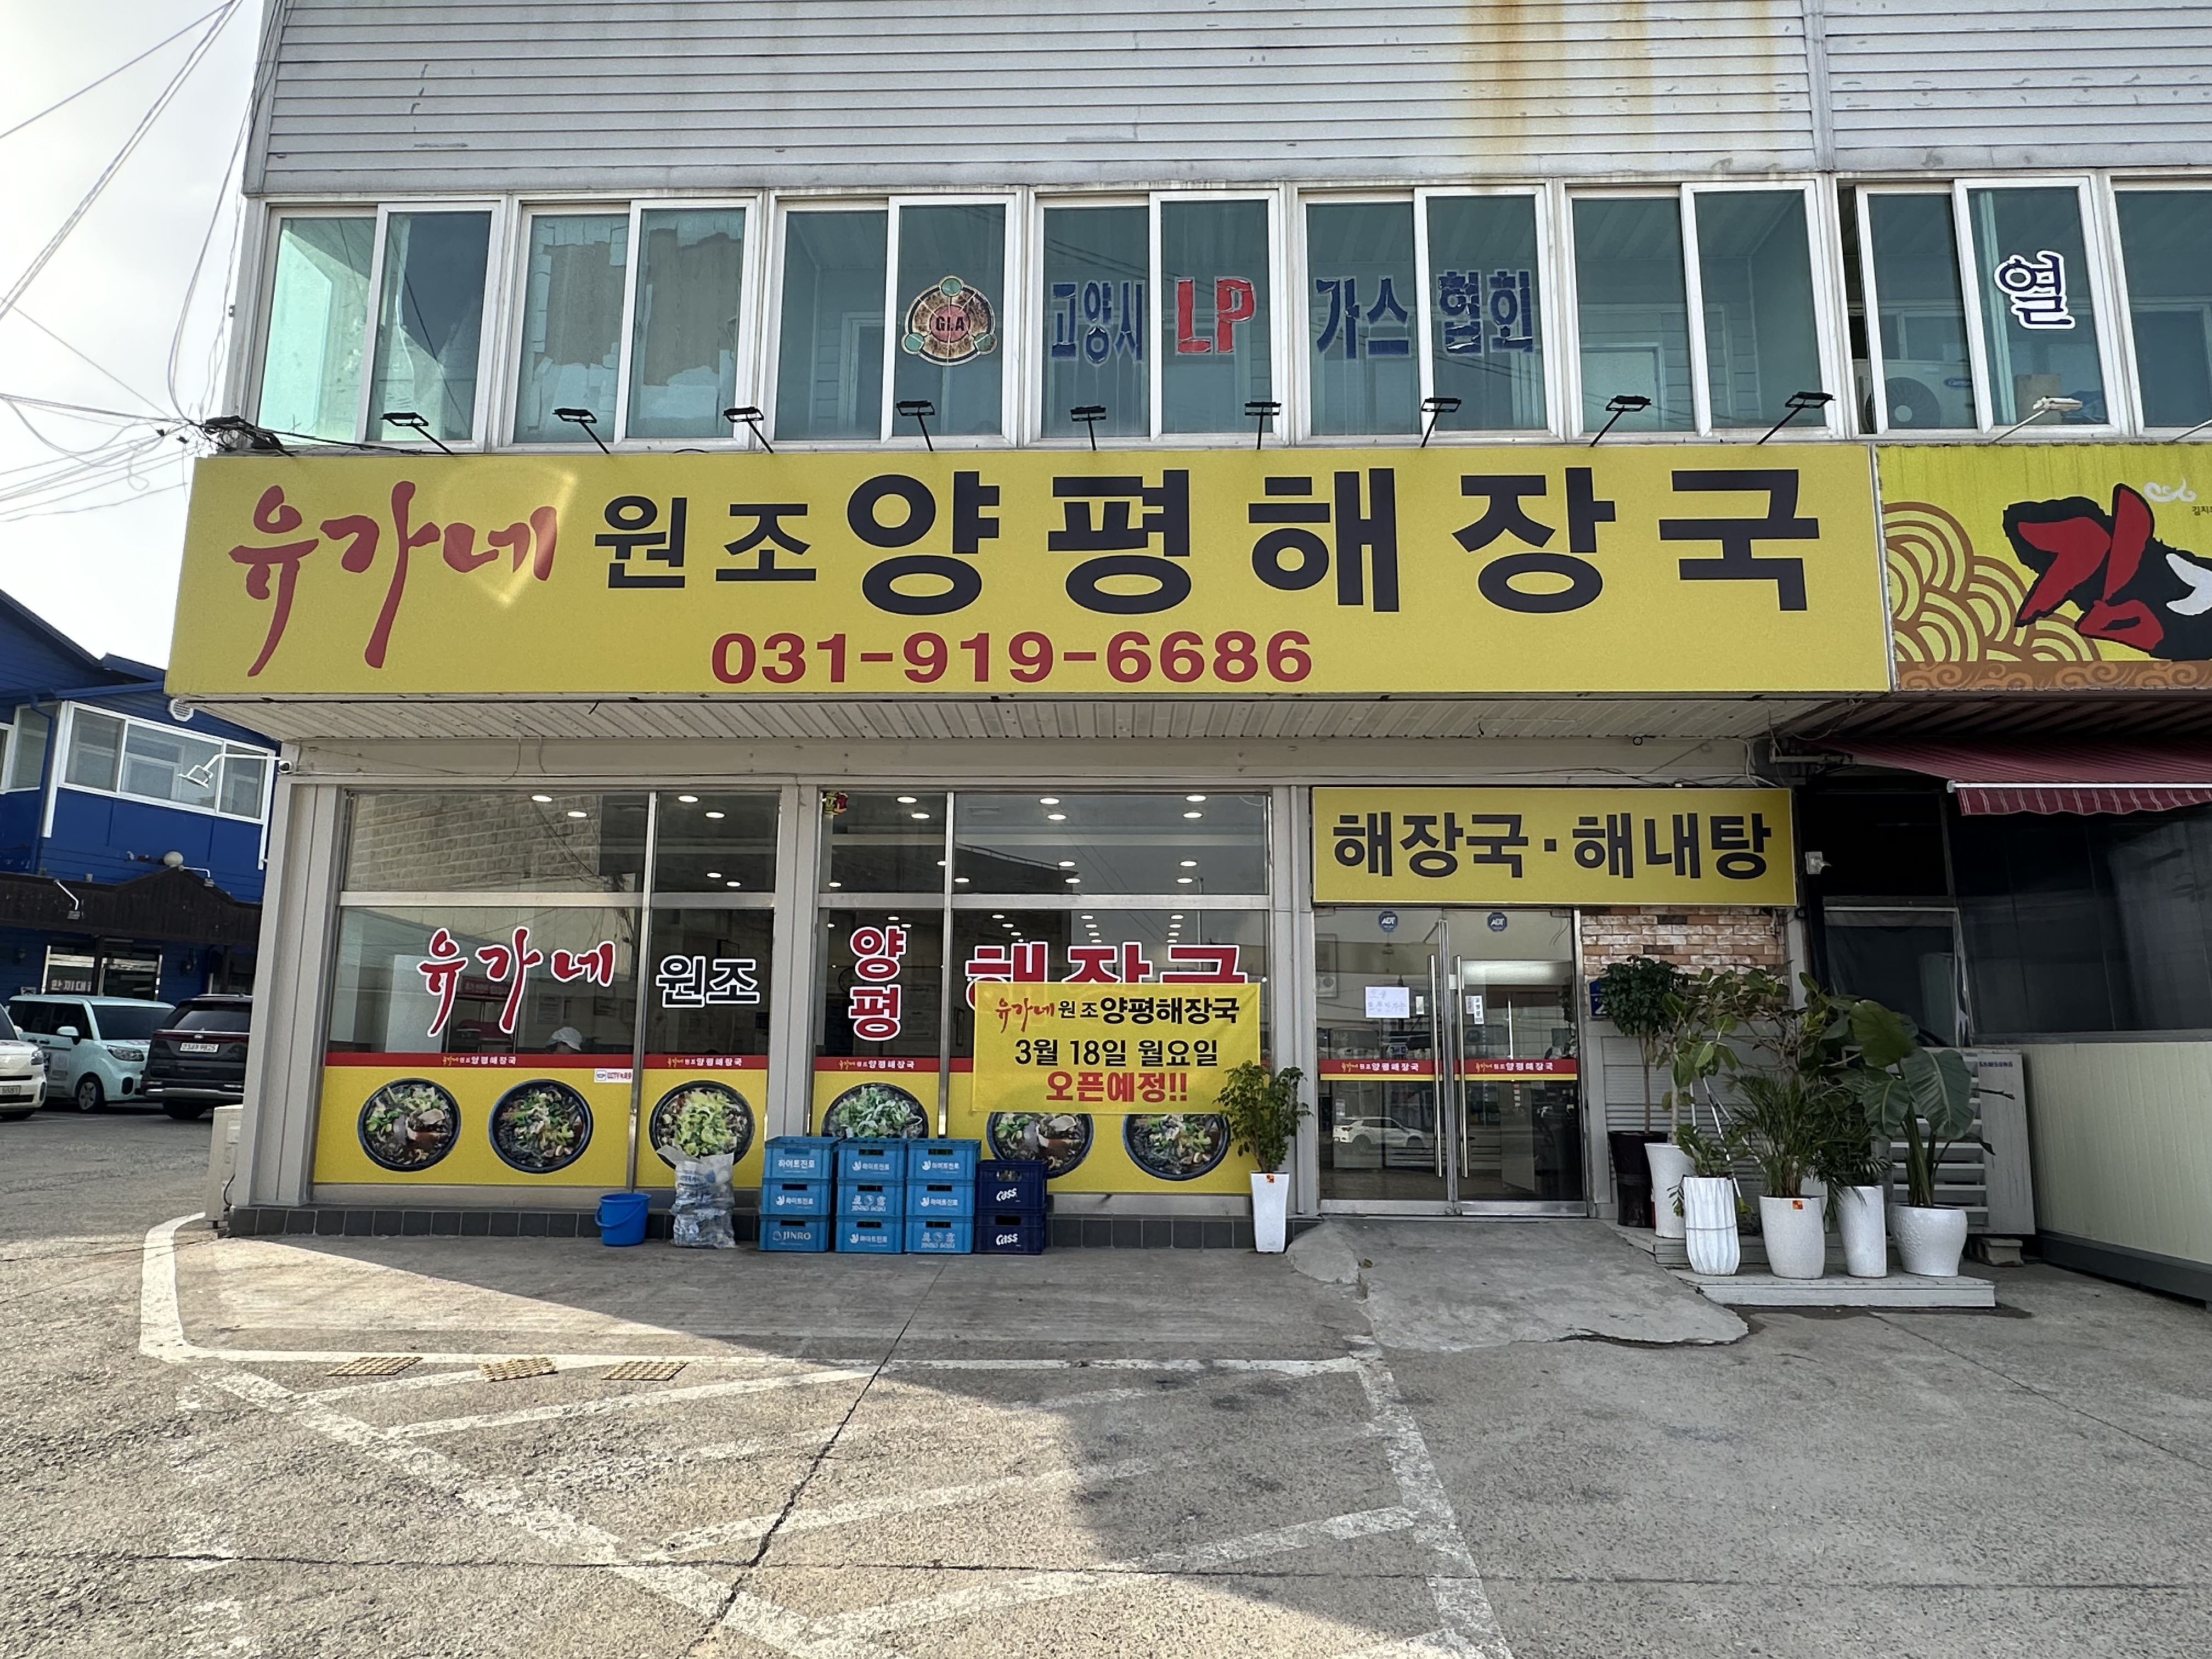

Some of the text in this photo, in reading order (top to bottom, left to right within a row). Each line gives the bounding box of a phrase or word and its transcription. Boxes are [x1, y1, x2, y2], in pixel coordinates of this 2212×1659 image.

[1051, 281, 1143, 363] 고양시
[1177, 279, 1254, 353] LP
[230, 484, 556, 676] 유가네
[847, 467, 1820, 616] 양평해장국
[712, 631, 1311, 684] 031-919-6686
[419, 928, 614, 1035] 유가네
[656, 955, 760, 1008] 원조
[995, 997, 1054, 1032] 유가네
[1101, 997, 1240, 1025] 양평해장국
[1015, 1039, 1218, 1067] 3월 18일 월요일
[1046, 1071, 1187, 1102] 오픈예정!!
[783, 1231, 811, 1240] JINRO
